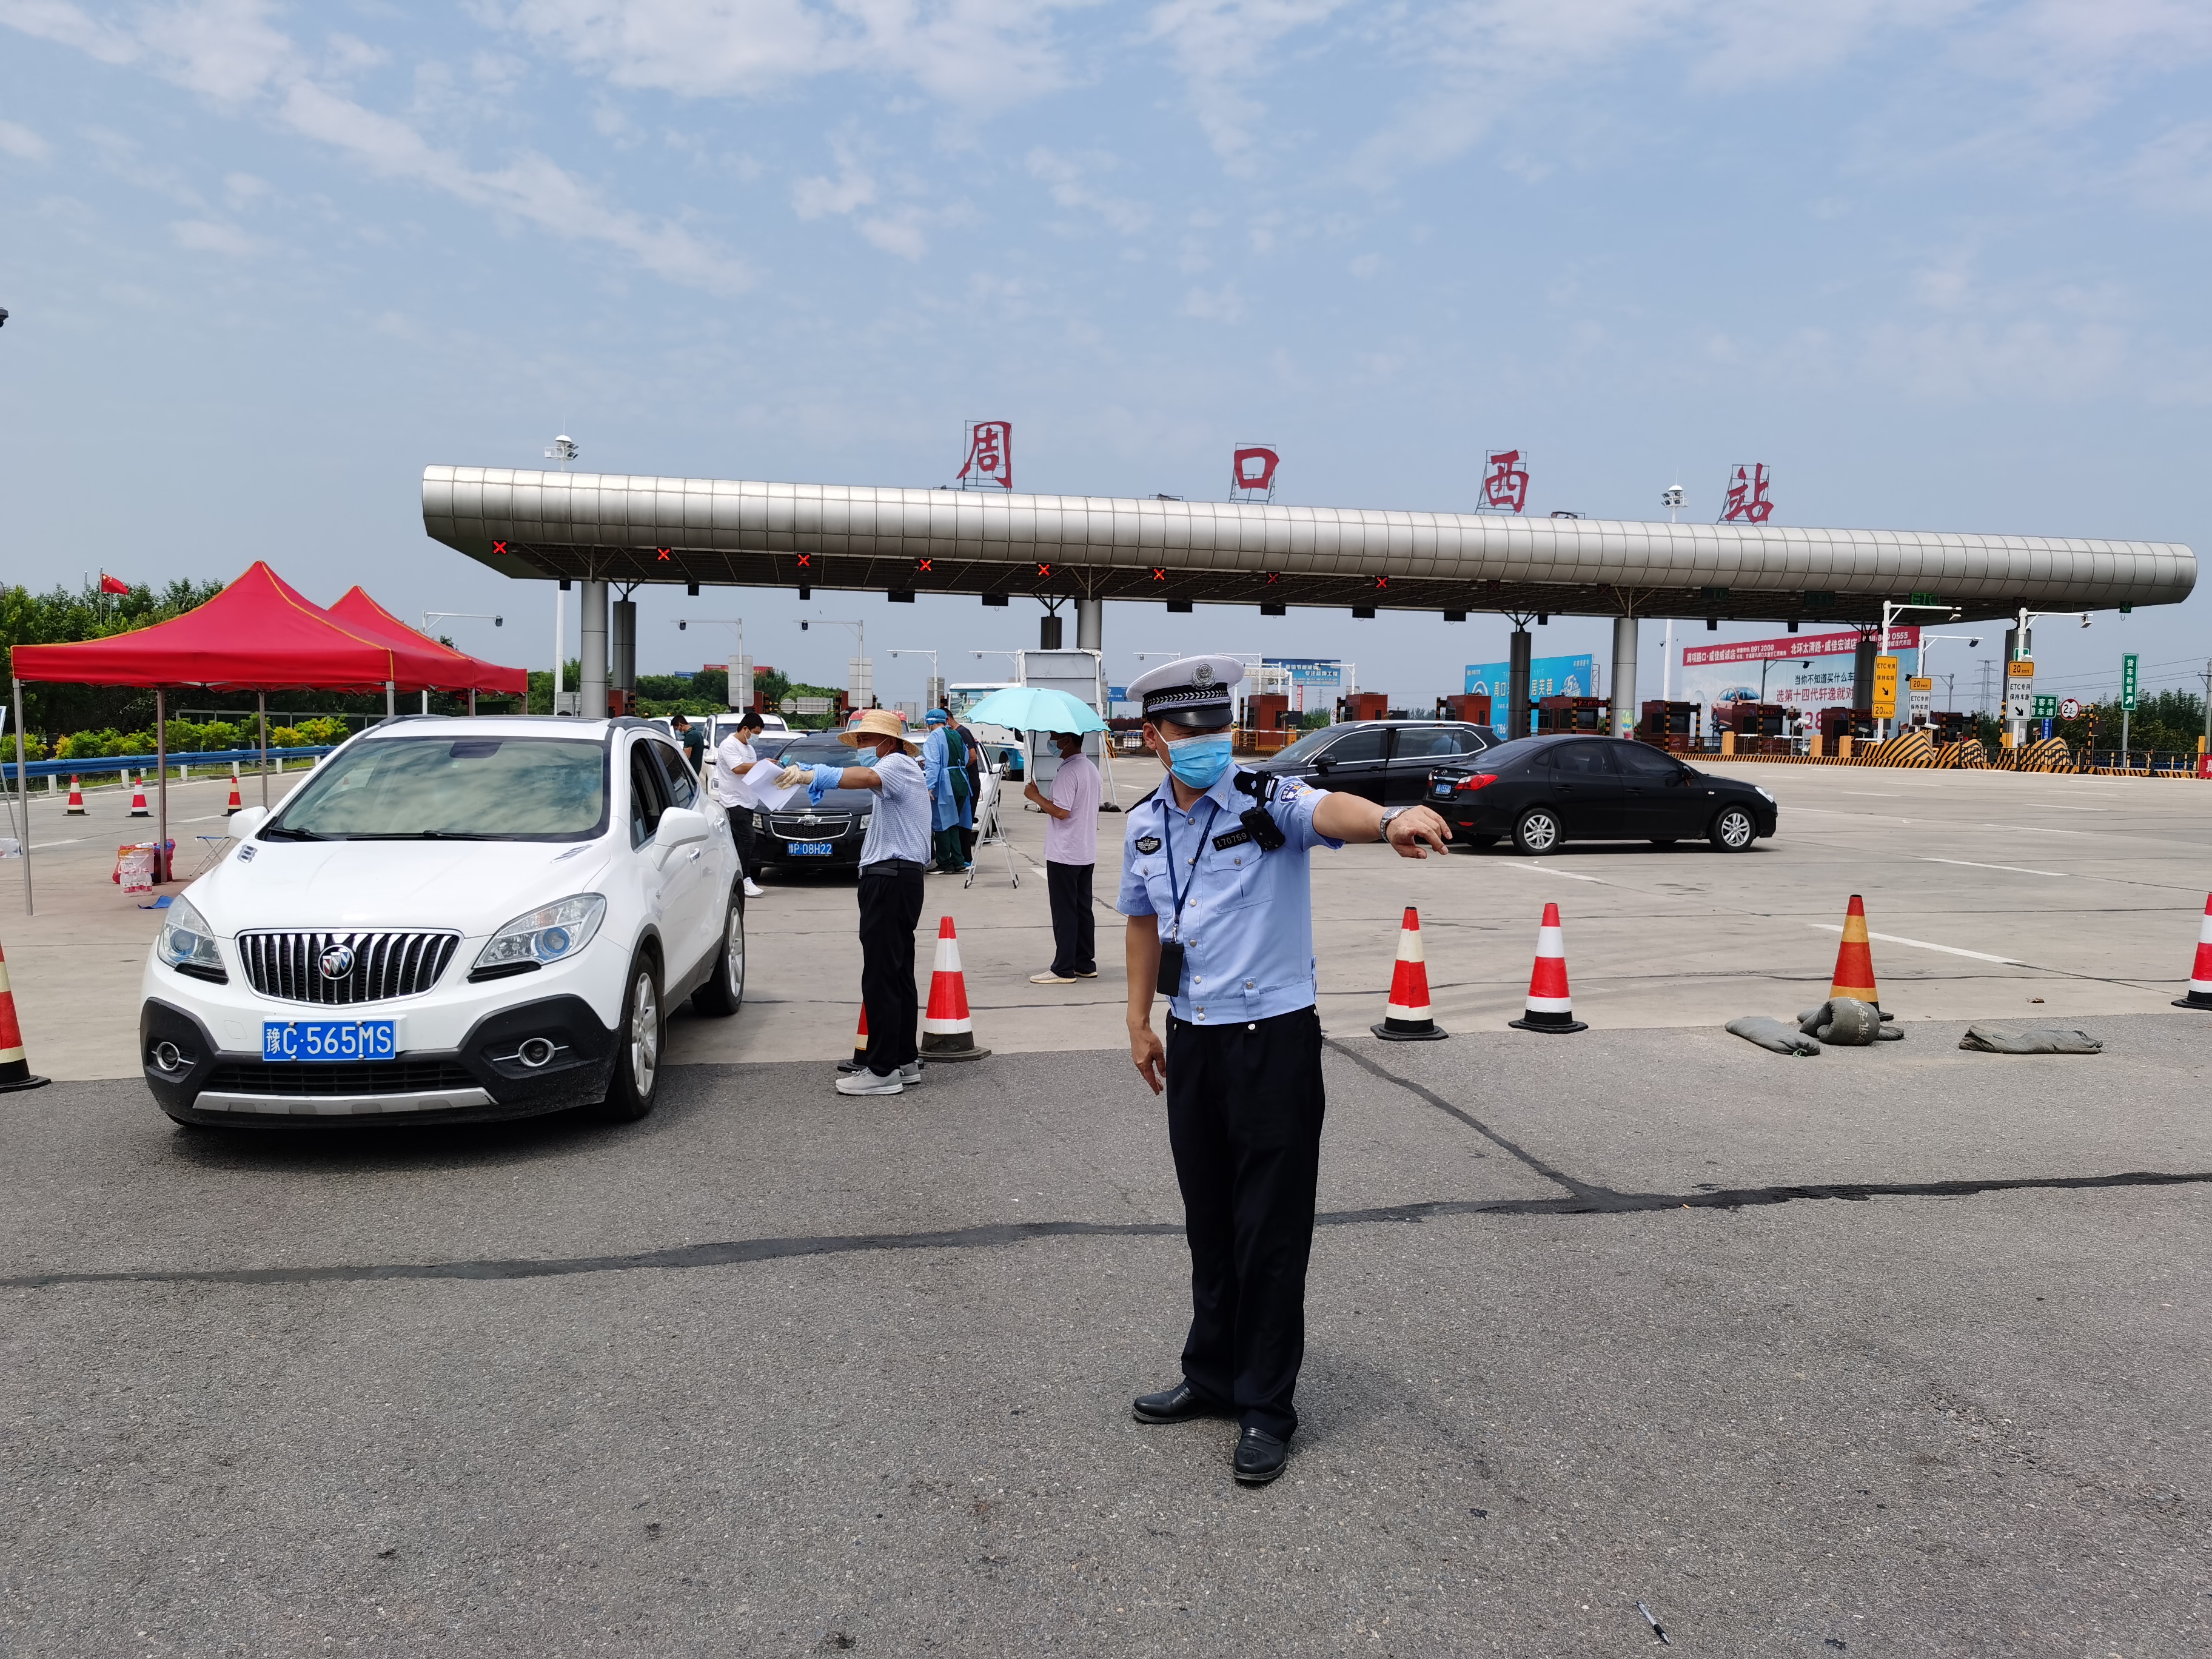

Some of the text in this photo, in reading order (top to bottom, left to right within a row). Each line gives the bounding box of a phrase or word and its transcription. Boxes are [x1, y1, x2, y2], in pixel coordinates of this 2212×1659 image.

[956, 421, 1774, 525] 周口西站
[1911, 593, 1939, 605] ETC
[2013, 665, 2020, 673] 20
[2125, 659, 2134, 694] 货车称重
[1794, 672, 1855, 686] 当你不知道买什么车
[1776, 686, 1854, 702] 选第十四代轩逸就对
[1216, 832, 1247, 848] 170759
